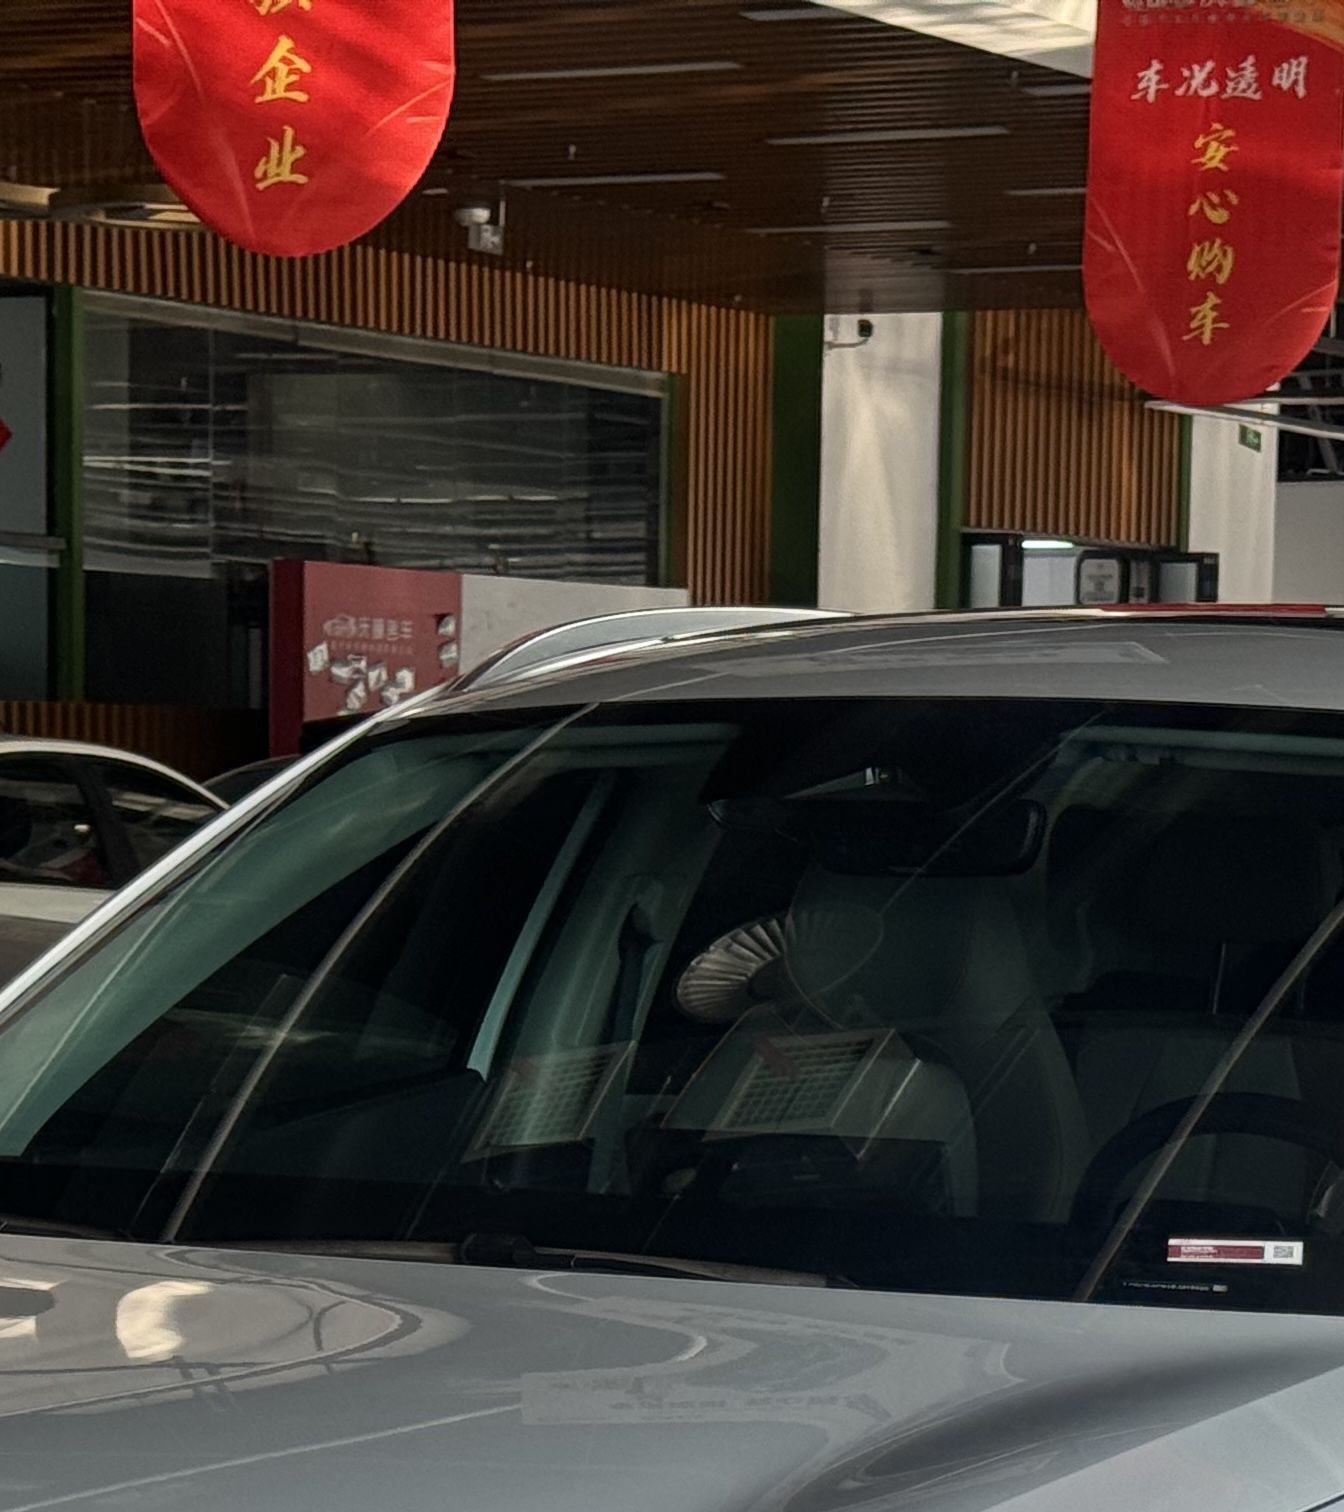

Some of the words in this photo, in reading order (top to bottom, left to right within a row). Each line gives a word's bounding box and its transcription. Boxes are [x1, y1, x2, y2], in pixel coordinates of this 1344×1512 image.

[248, 0, 312, 191] 企业
[1130, 54, 1308, 104] 车况透明
[1181, 122, 1240, 346] 安心购车
